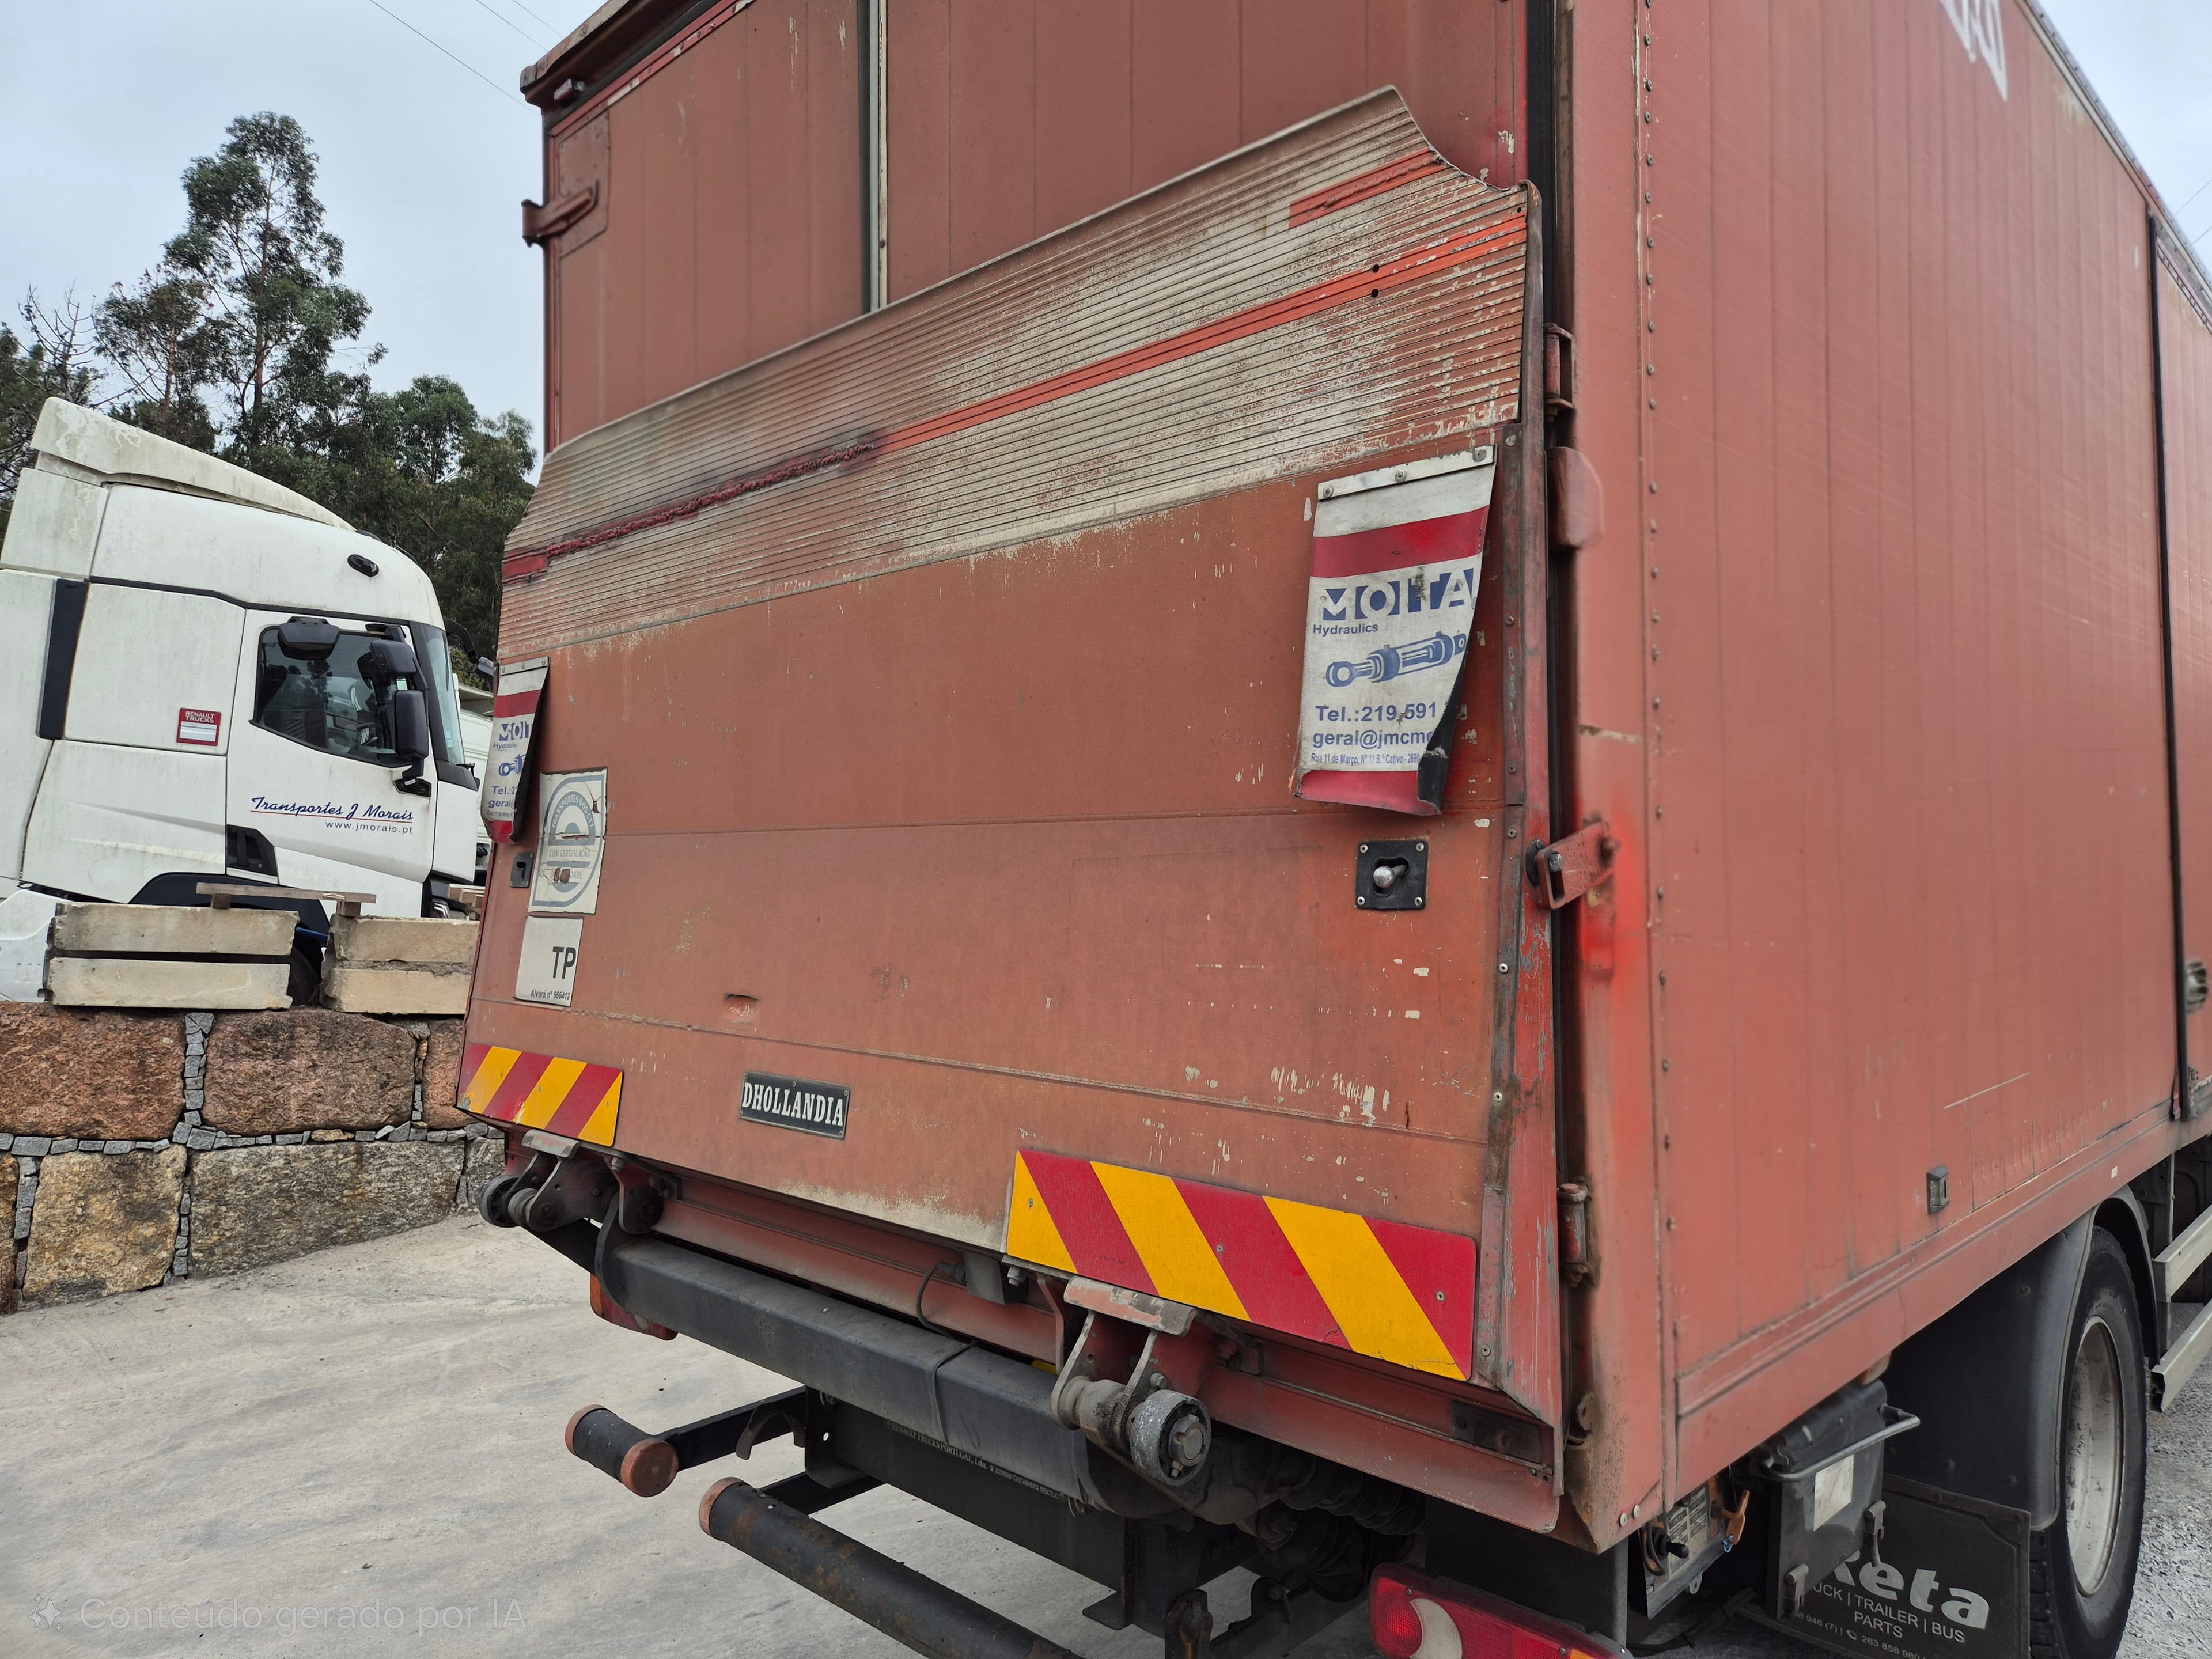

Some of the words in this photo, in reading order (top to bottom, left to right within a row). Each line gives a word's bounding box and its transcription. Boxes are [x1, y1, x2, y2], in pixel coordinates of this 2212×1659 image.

[1312, 623, 1378, 637] Hydraulics
[185, 710, 215, 719] RENAULT
[185, 715, 214, 724] TRUCKS
[1315, 704, 1397, 722] Tel.:219
[1404, 702, 1437, 720] 591
[1310, 752, 1323, 763] Rua
[1324, 753, 1330, 763] 11
[1331, 753, 1339, 763] de
[1340, 753, 1359, 767] Março,
[1369, 754, 1374, 764] 11
[251, 796, 344, 817] Transportes
[346, 803, 359, 820] J
[362, 805, 414, 820] Morais
[552, 794, 579, 828] TRANSPORTES
[578, 798, 589, 814] DOS
[325, 820, 413, 835] www.jmorais.pt
[549, 849, 559, 858] COM
[552, 946, 577, 979] TP
[530, 988, 546, 998] Alvará
[741, 1082, 843, 1127] DHOLLANDIA
[1854, 1594, 1919, 1628] TRAILER
[1931, 1621, 1965, 1643] BUS
[1854, 1611, 1903, 1639] PARTS
[1806, 1615, 1823, 1627] 946
[1825, 1622, 1838, 1634] (7)
[1861, 1635, 1879, 1648] 263
[1881, 1642, 1900, 1655] 858
